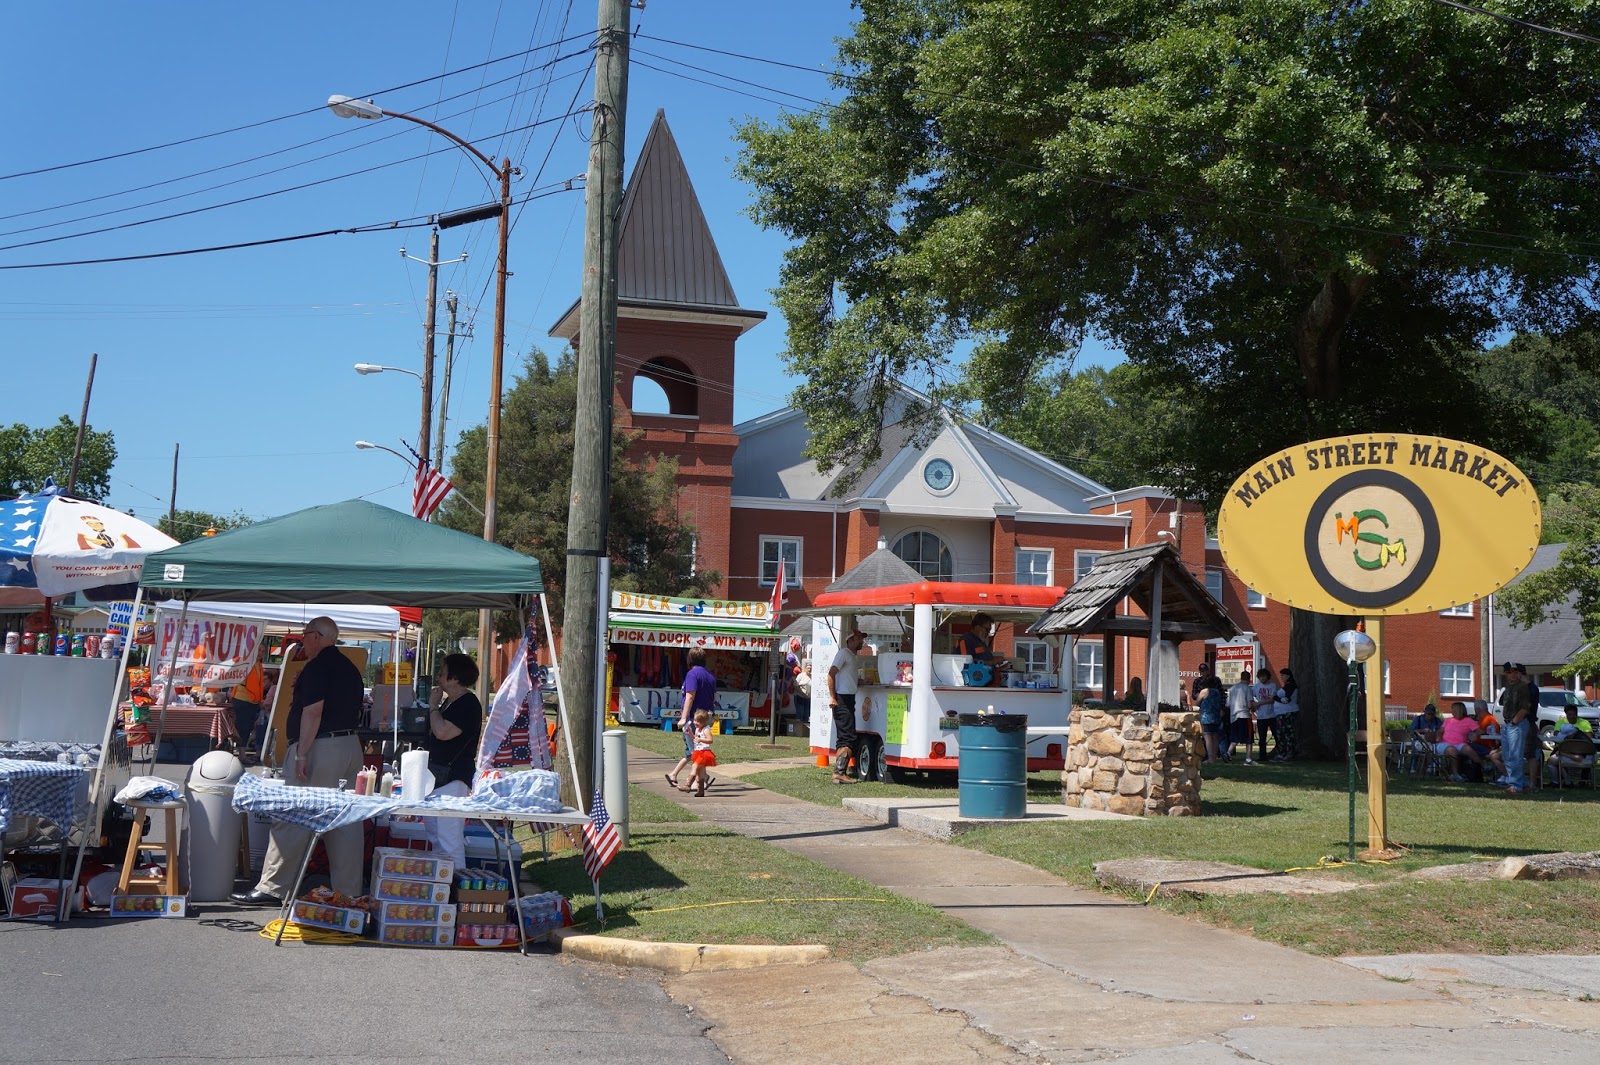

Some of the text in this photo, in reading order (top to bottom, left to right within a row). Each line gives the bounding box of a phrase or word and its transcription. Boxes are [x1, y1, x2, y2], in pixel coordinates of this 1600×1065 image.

[1235, 441, 1520, 508] MAIN STREET MARKET
[619, 592, 767, 617] DUCK POND
[617, 630, 780, 648] PICK A DUCK WIN A PRIZ
[1217, 647, 1253, 659] First Baptist Church
[156, 663, 248, 680] Cajn Boiled Roasted
